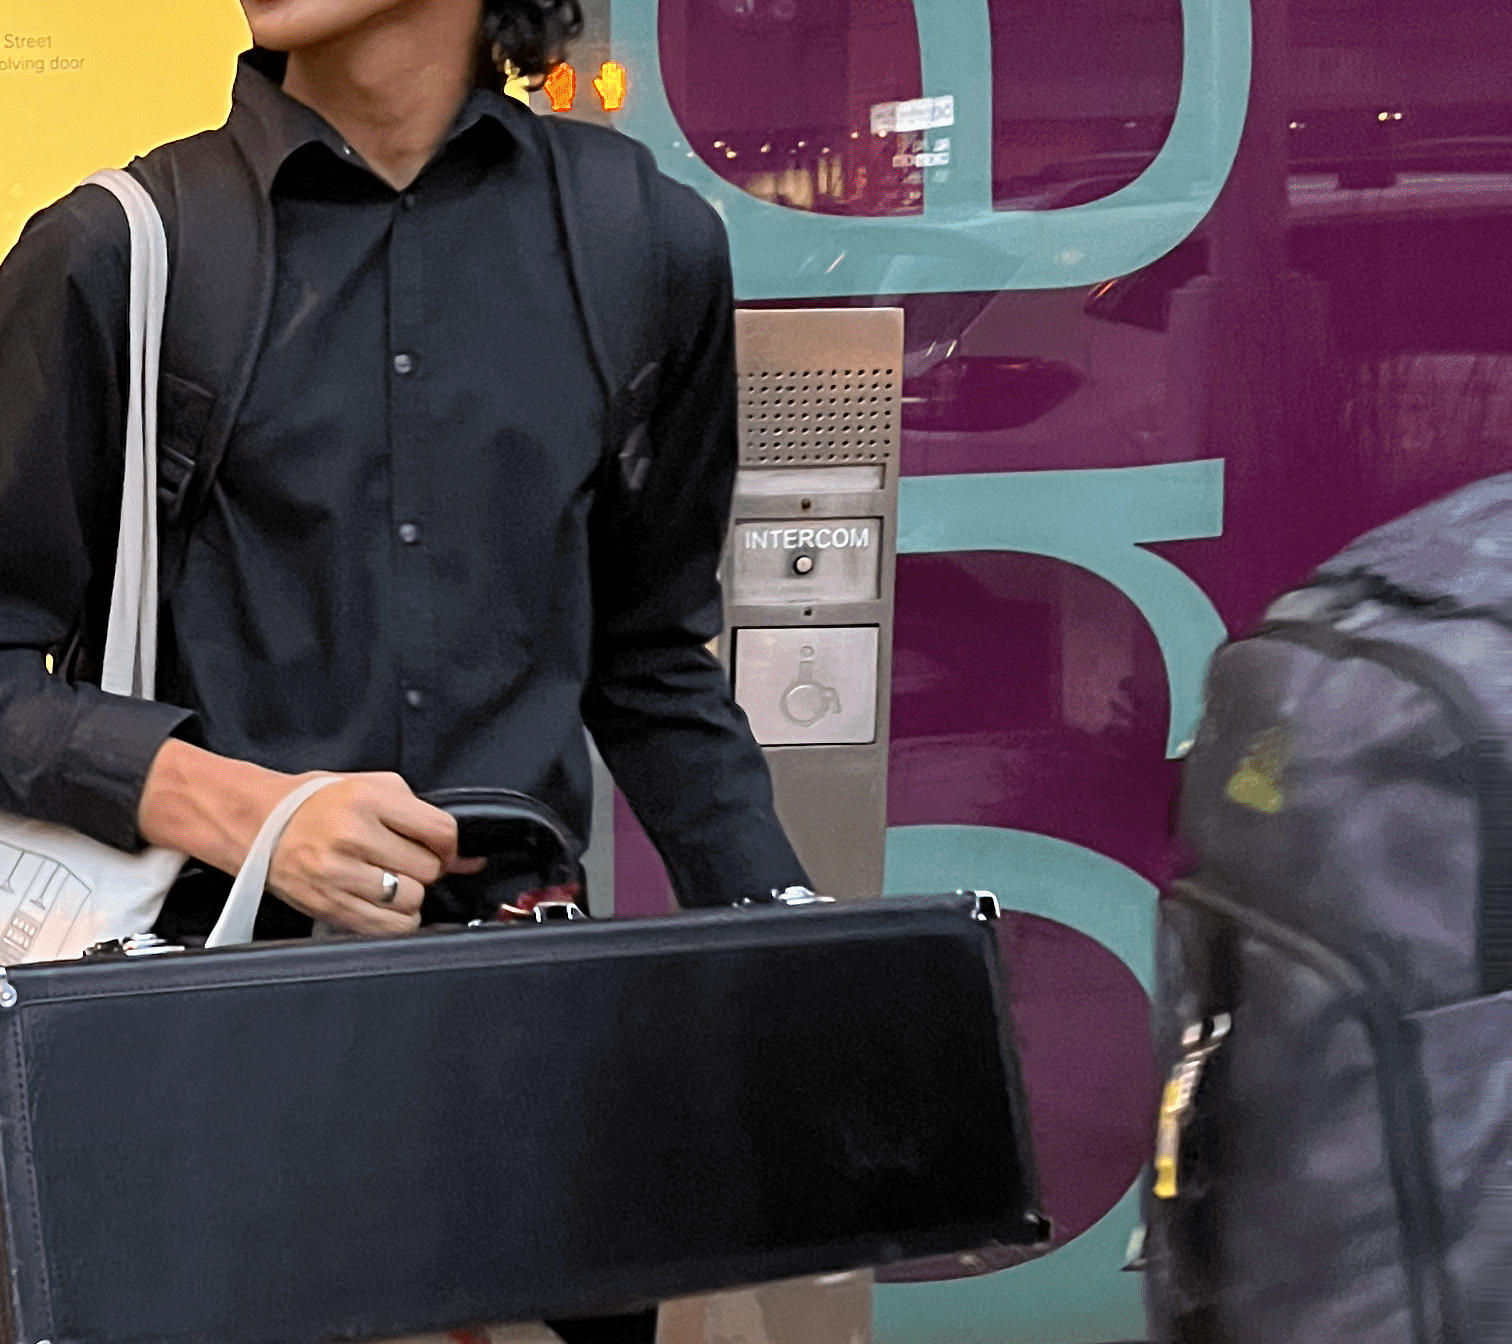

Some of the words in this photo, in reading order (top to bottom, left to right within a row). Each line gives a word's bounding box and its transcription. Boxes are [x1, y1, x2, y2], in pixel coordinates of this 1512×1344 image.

[4, 33, 52, 48] Street
[50, 56, 85, 70] door
[744, 527, 870, 549] INTERCOM
